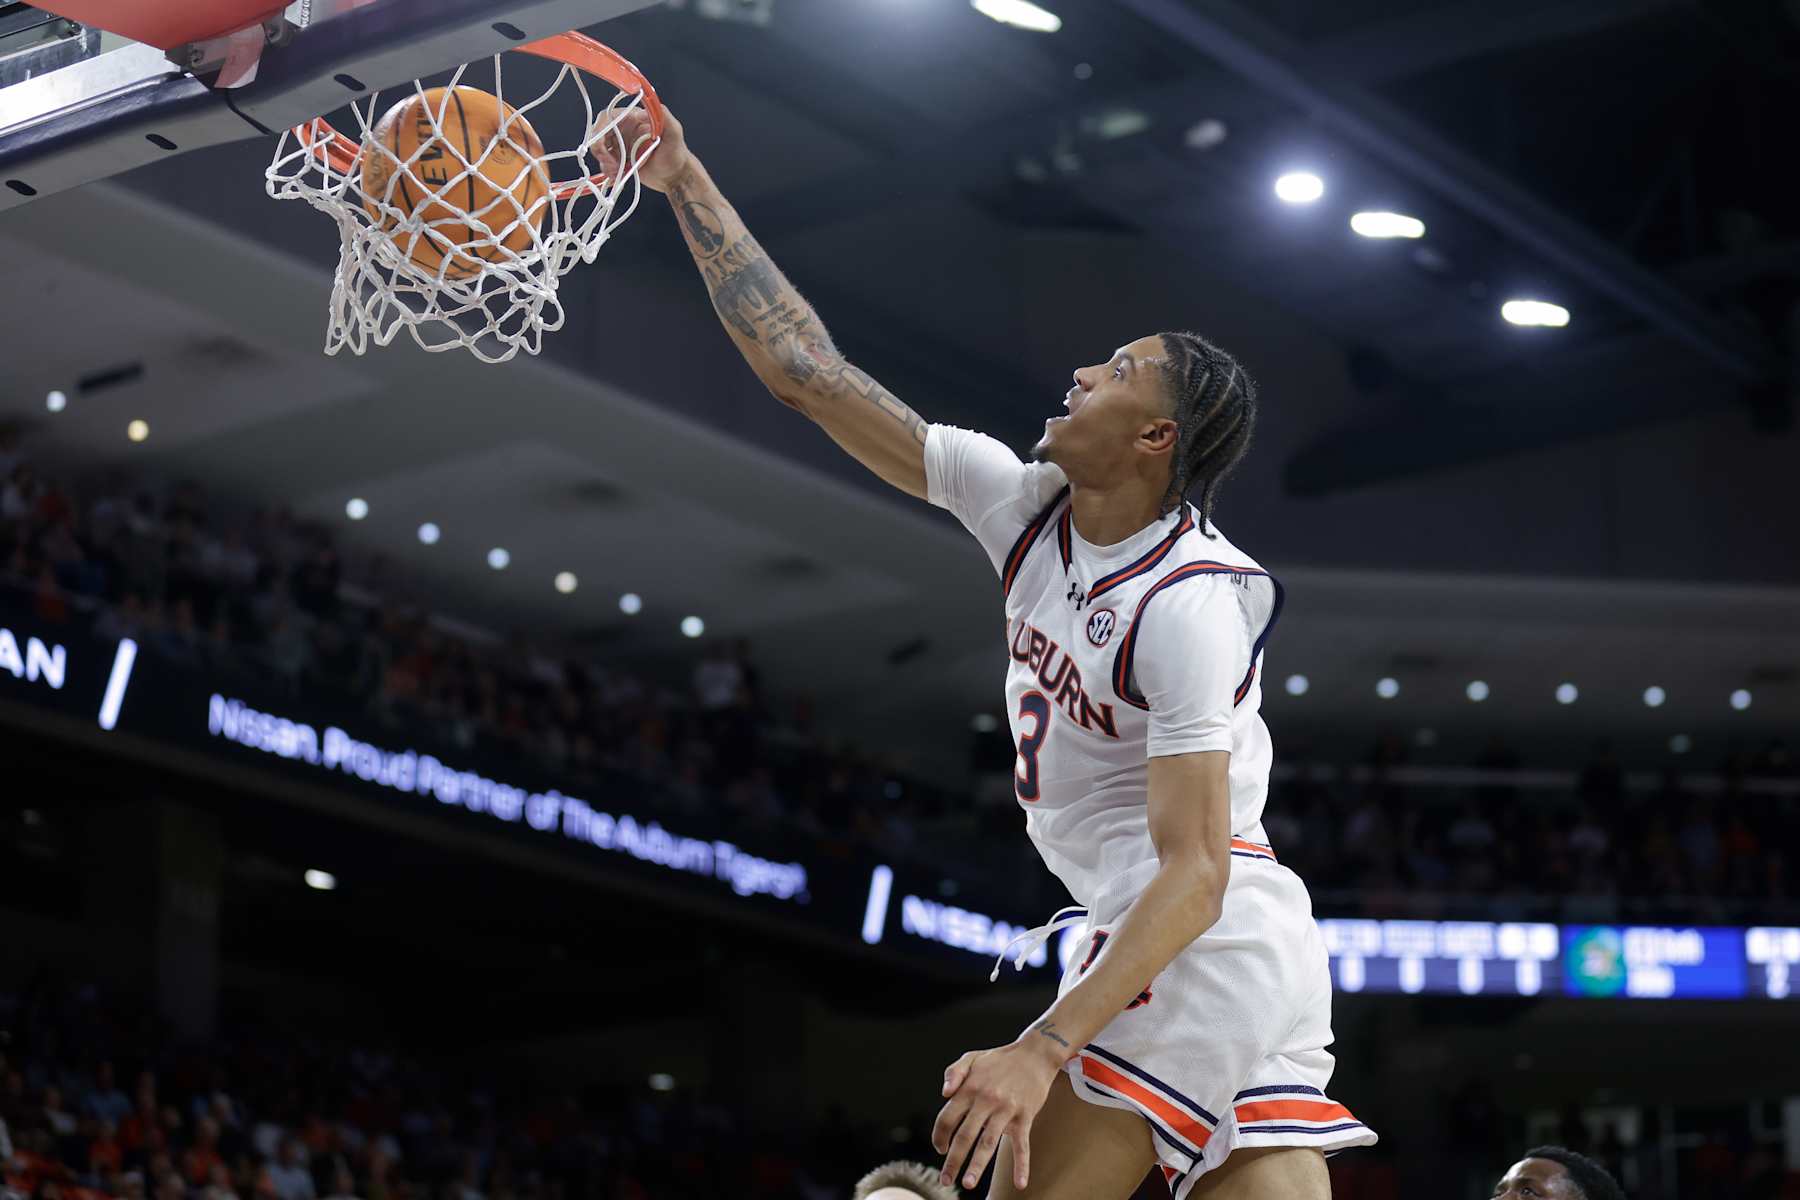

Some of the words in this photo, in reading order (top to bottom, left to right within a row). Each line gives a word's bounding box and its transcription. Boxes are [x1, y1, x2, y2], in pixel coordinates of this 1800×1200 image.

[1006, 616, 1120, 740] UBURN
[322, 726, 418, 792] Proud
[416, 754, 527, 822] Partner
[525, 789, 562, 832] of
[614, 814, 714, 876] Auburn
[1014, 690, 1052, 802] 3
